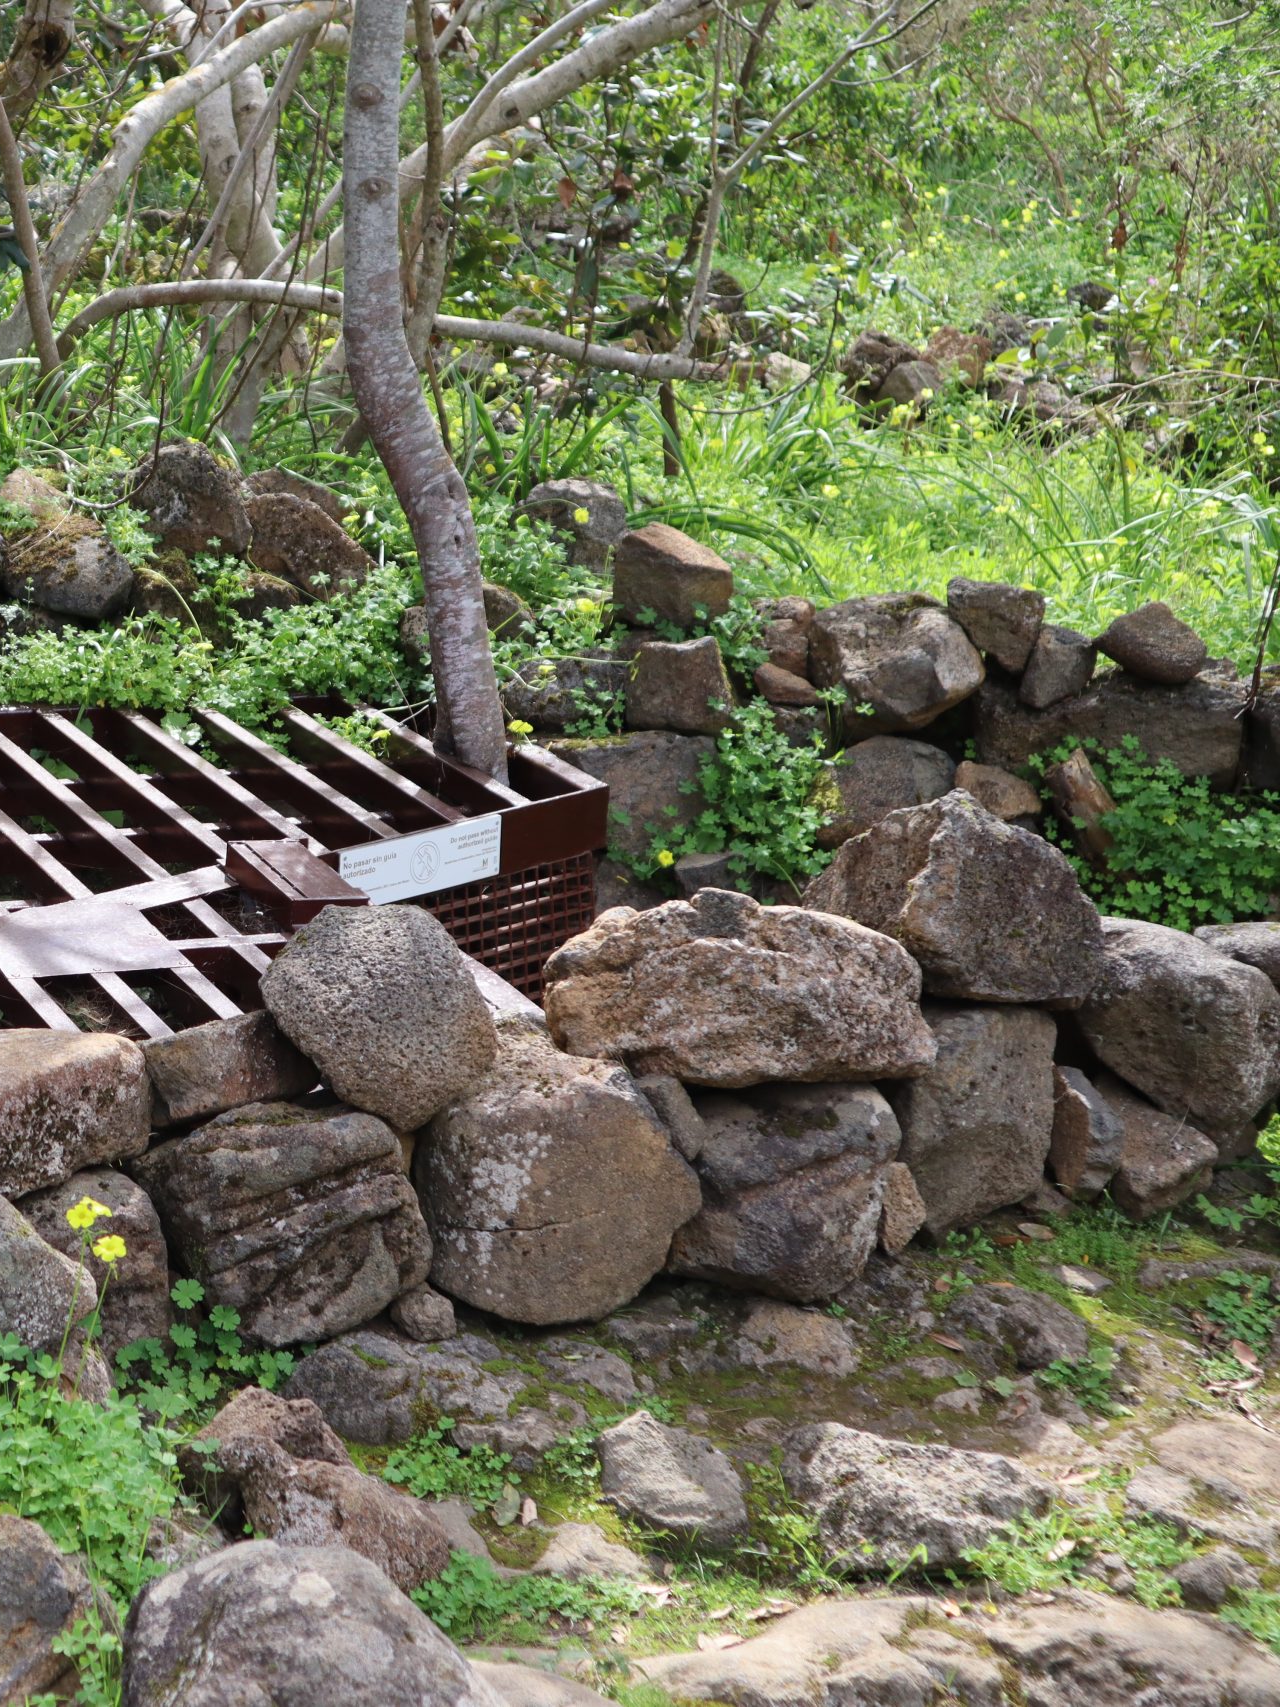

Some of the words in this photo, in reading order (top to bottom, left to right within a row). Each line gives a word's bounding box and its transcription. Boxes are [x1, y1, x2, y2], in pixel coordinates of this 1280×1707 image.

[467, 832, 480, 840] pass
[480, 827, 498, 836] without
[353, 858, 372, 869] pasar
[343, 866, 376, 879] autorizado
